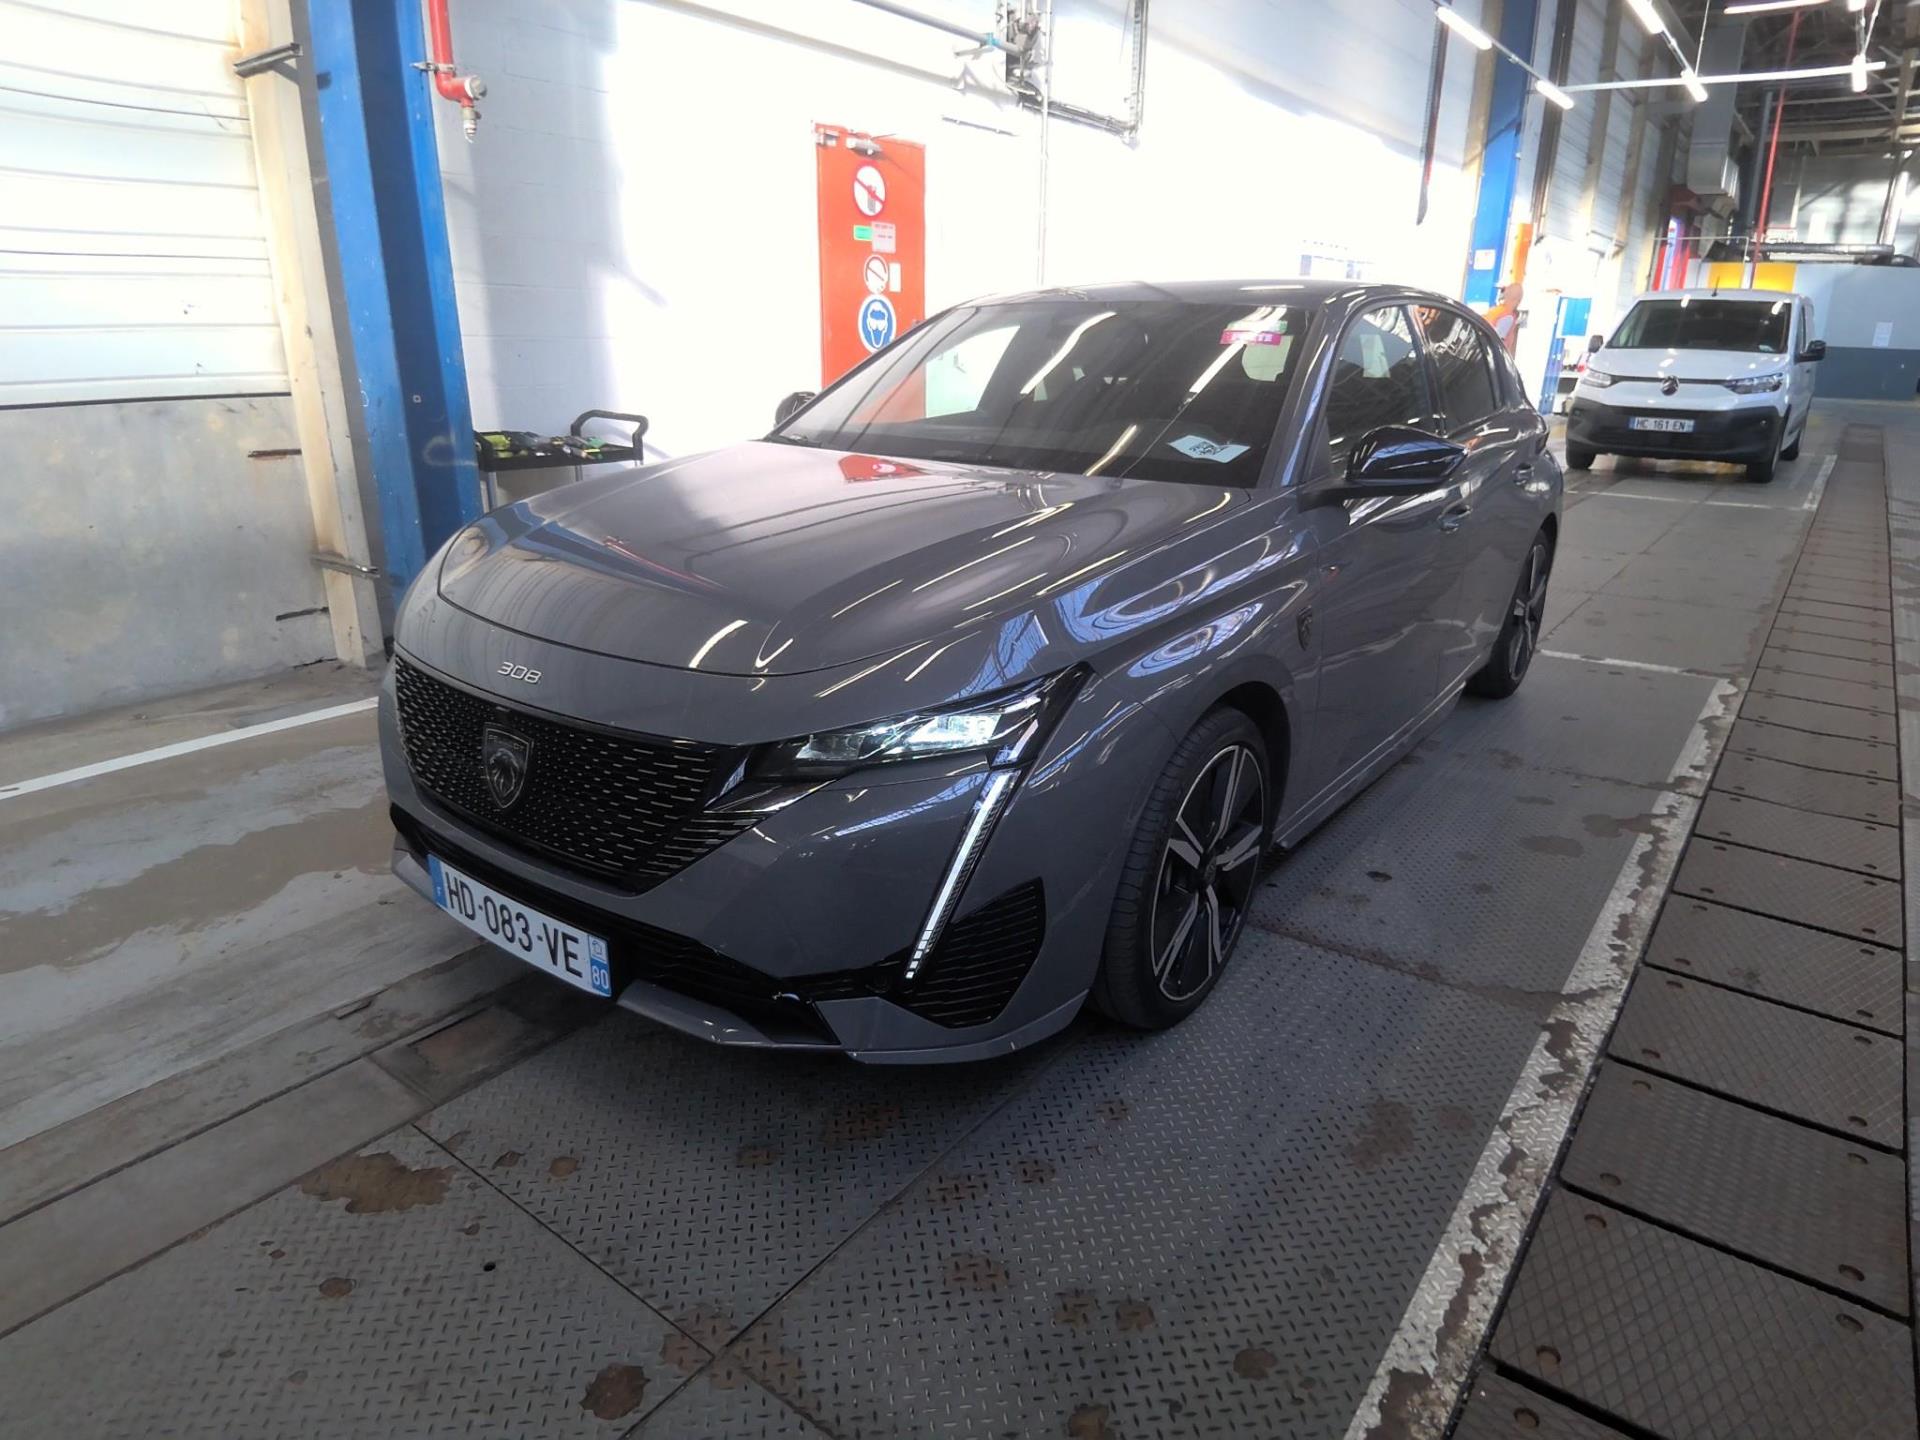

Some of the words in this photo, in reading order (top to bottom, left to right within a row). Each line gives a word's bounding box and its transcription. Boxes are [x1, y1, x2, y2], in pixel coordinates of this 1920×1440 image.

[497, 661, 541, 683] 308
[445, 871, 583, 978] HD-083-VE
[592, 965, 609, 989] 80
